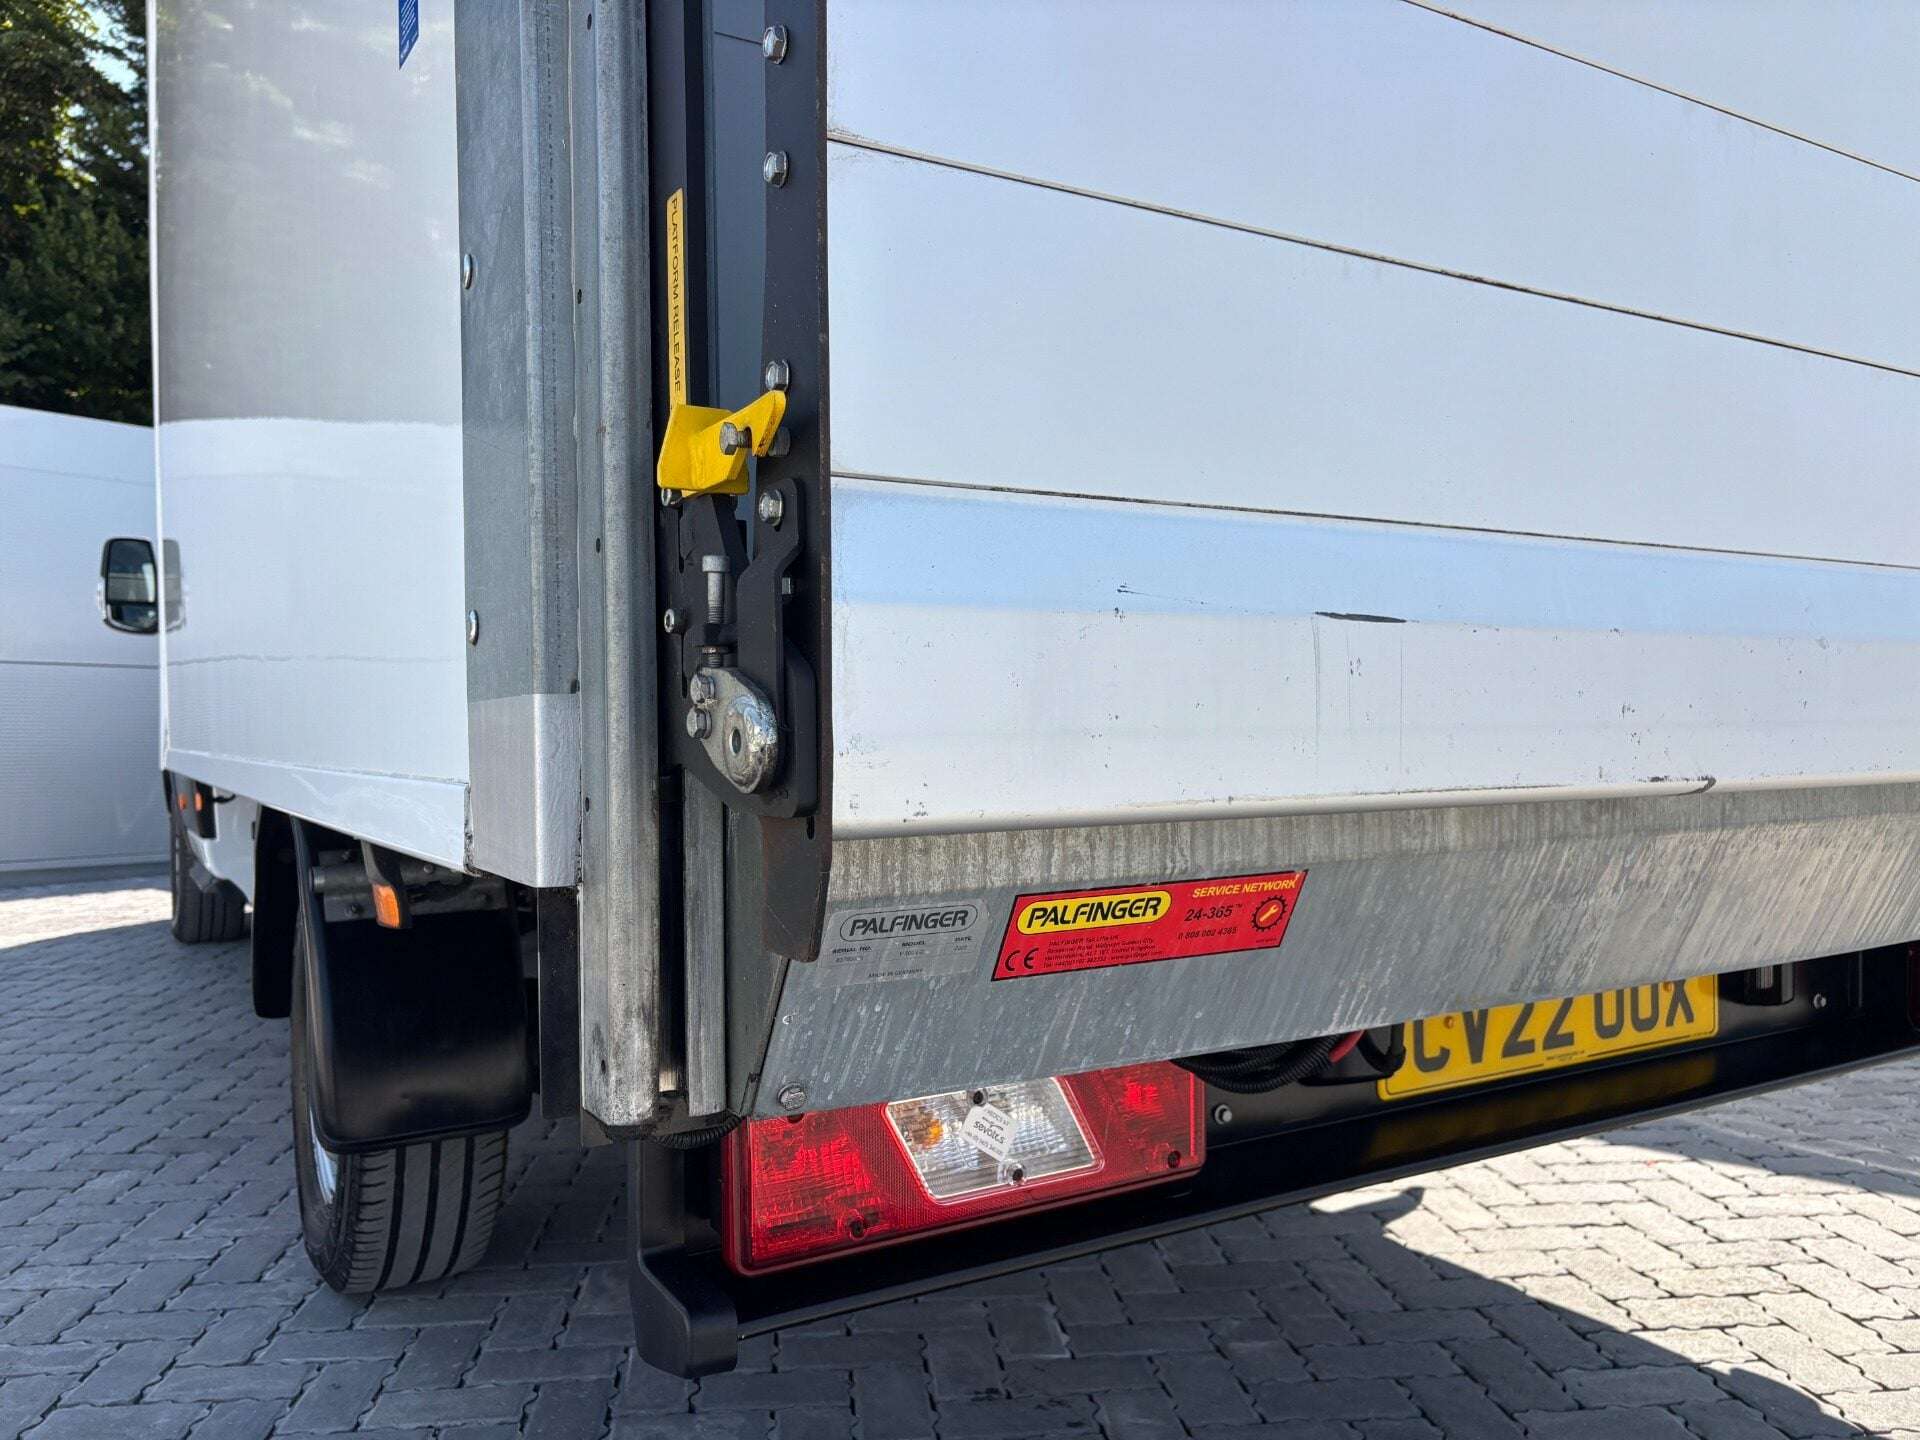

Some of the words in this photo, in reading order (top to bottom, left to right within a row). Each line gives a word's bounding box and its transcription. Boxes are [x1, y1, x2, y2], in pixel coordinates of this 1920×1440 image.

[671, 197, 679, 301] PLATFORM
[673, 305, 681, 392] RELEASE
[1192, 884, 1241, 898] SERVICE
[1241, 879, 1297, 894] NETWORK
[849, 909, 969, 937] PALFINGER
[1026, 896, 1162, 929] PALFINGER
